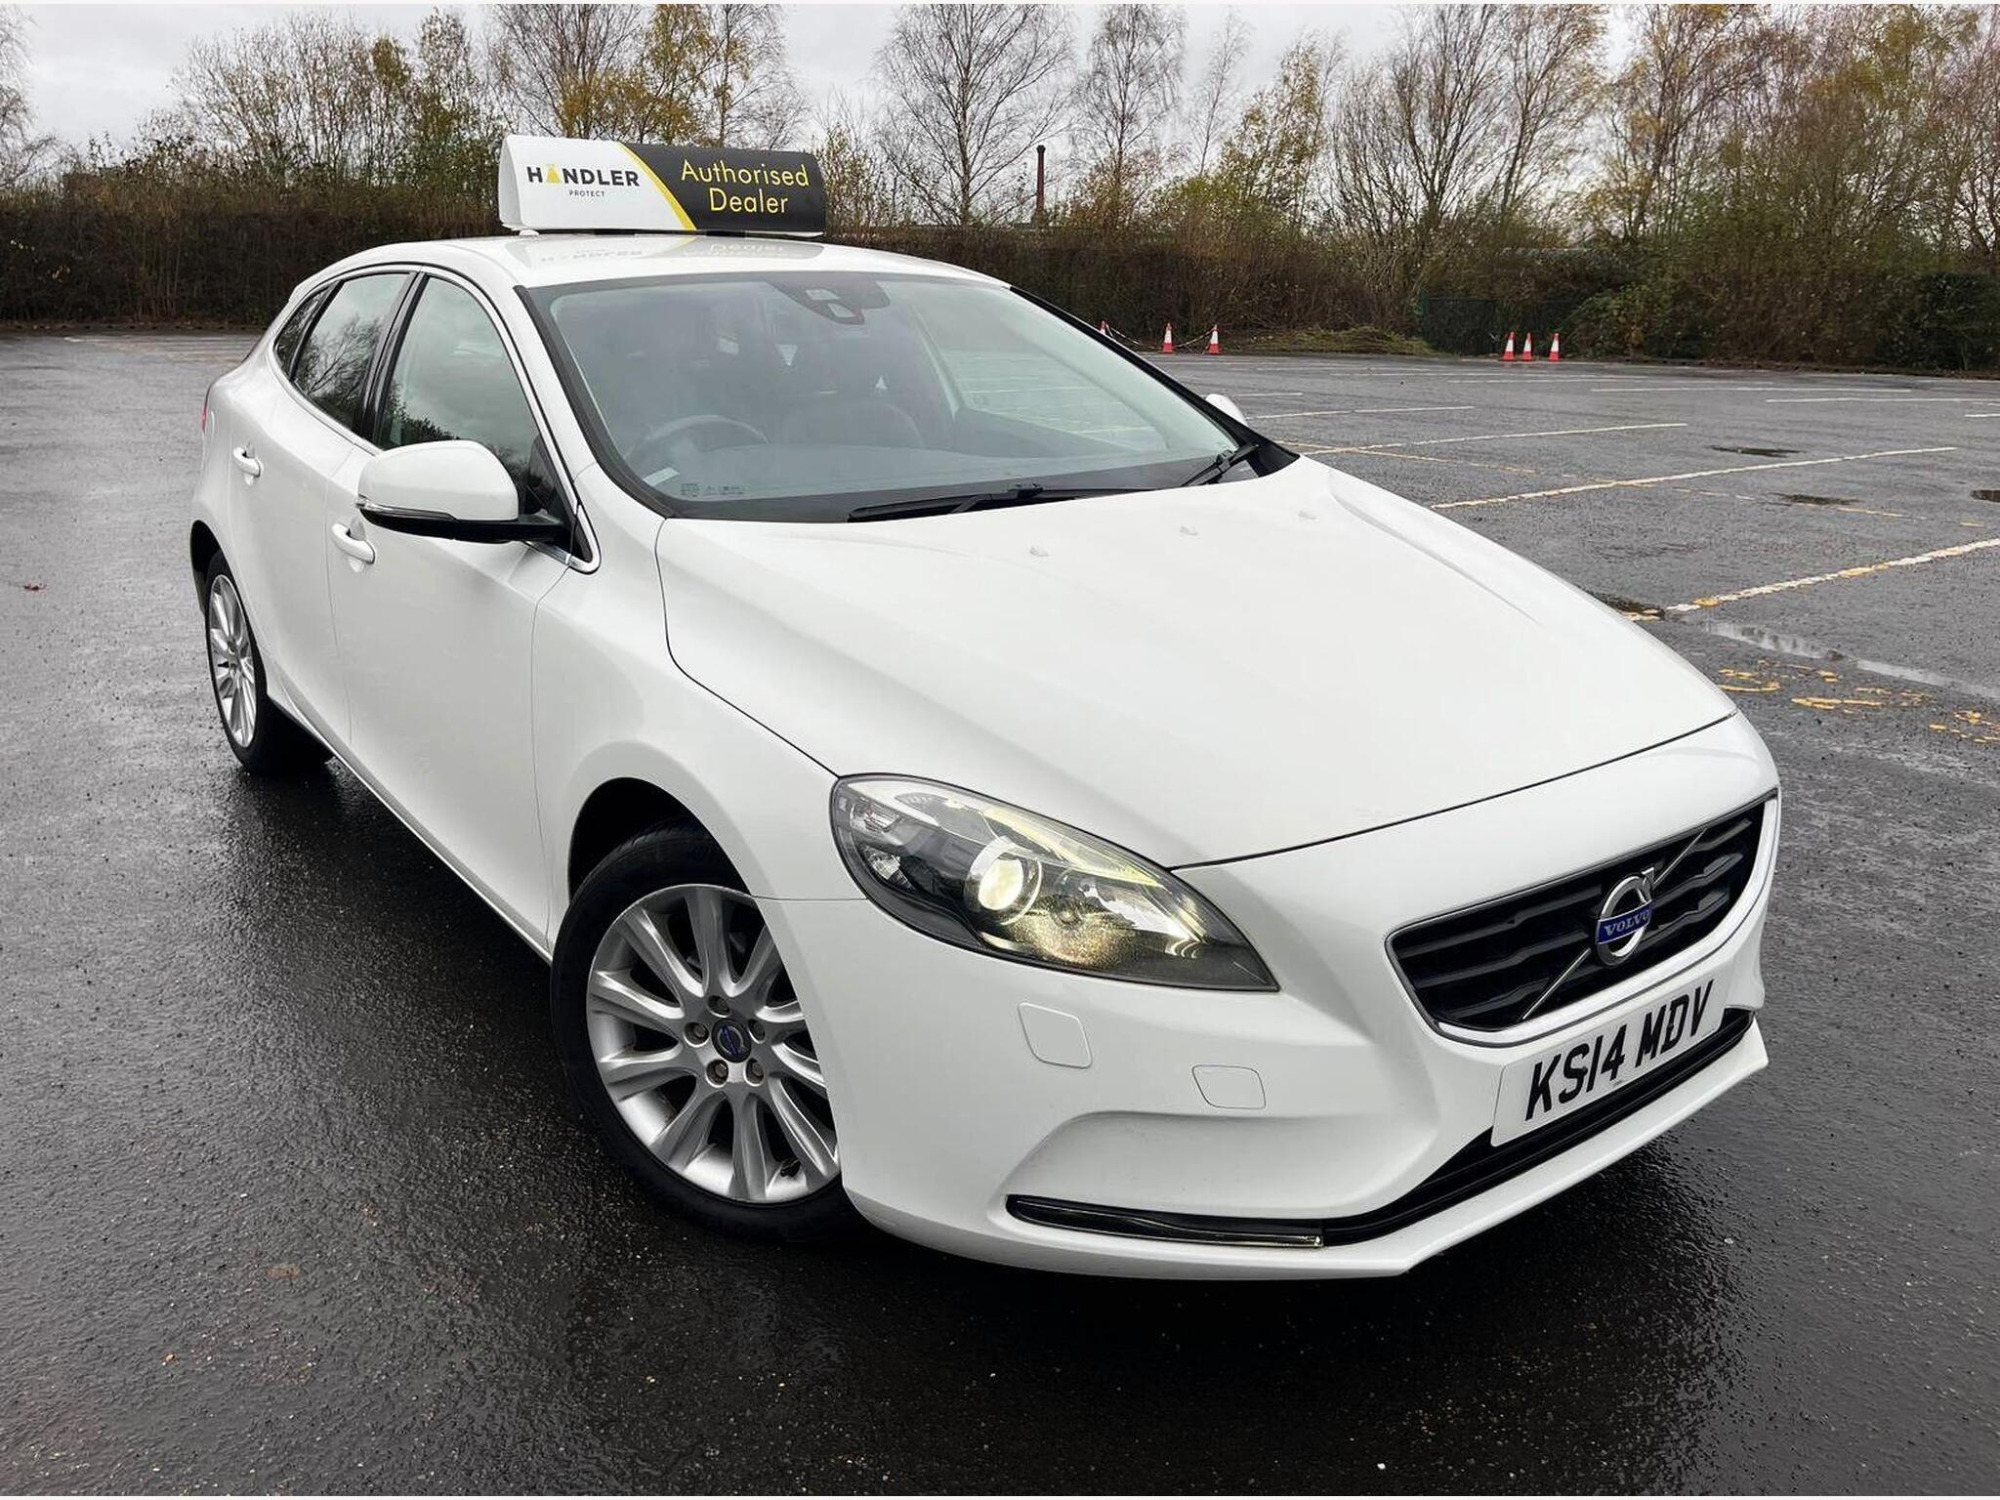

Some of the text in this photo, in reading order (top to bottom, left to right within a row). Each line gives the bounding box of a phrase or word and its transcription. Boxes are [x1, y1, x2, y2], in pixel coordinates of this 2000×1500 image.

[681, 159, 810, 187] Authorised
[569, 189, 605, 198] PROTECT
[709, 188, 788, 213] Dealer
[1603, 909, 1650, 936] VOLVO
[1525, 979, 1714, 1121] KS14 MDV
